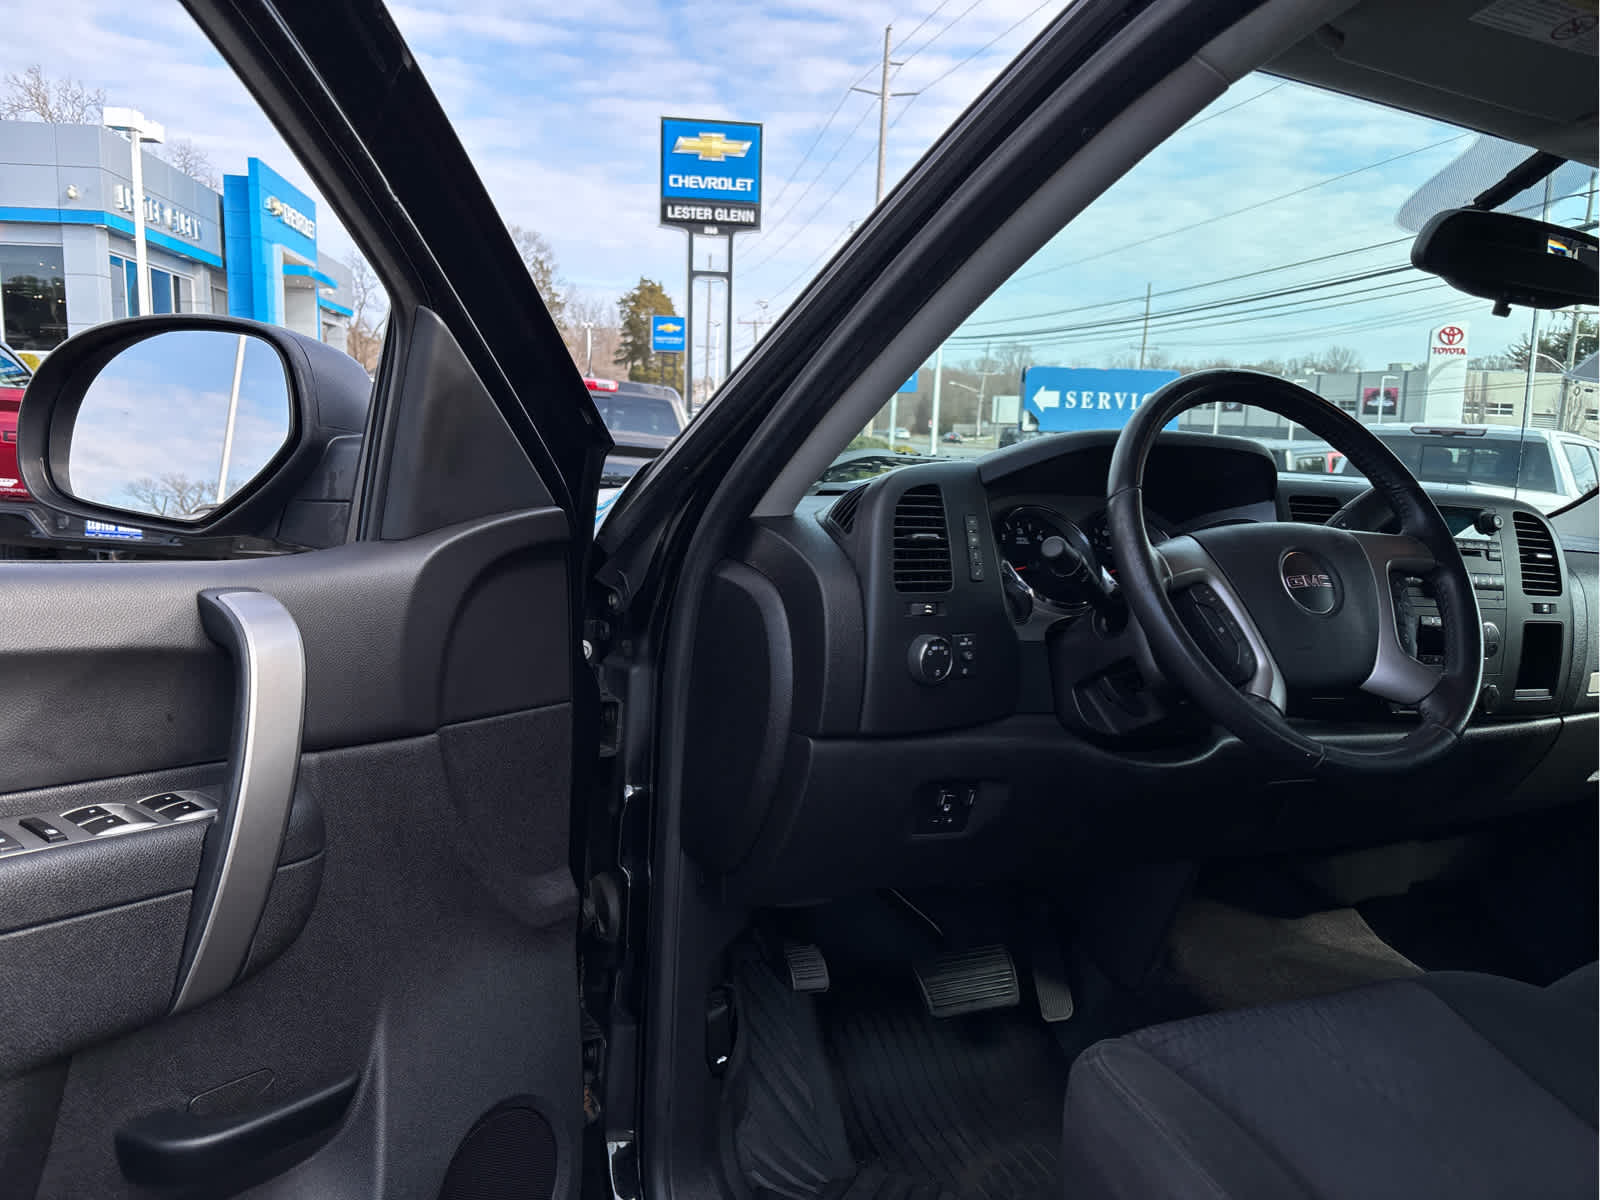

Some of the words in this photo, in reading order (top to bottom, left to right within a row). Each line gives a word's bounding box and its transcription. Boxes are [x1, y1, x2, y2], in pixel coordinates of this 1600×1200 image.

[668, 174, 755, 192] CHEVROLET
[667, 205, 713, 220] LESTER
[714, 208, 755, 223] GLENN
[1432, 346, 1467, 355] TOYOTA
[1286, 574, 1333, 589] GMC
